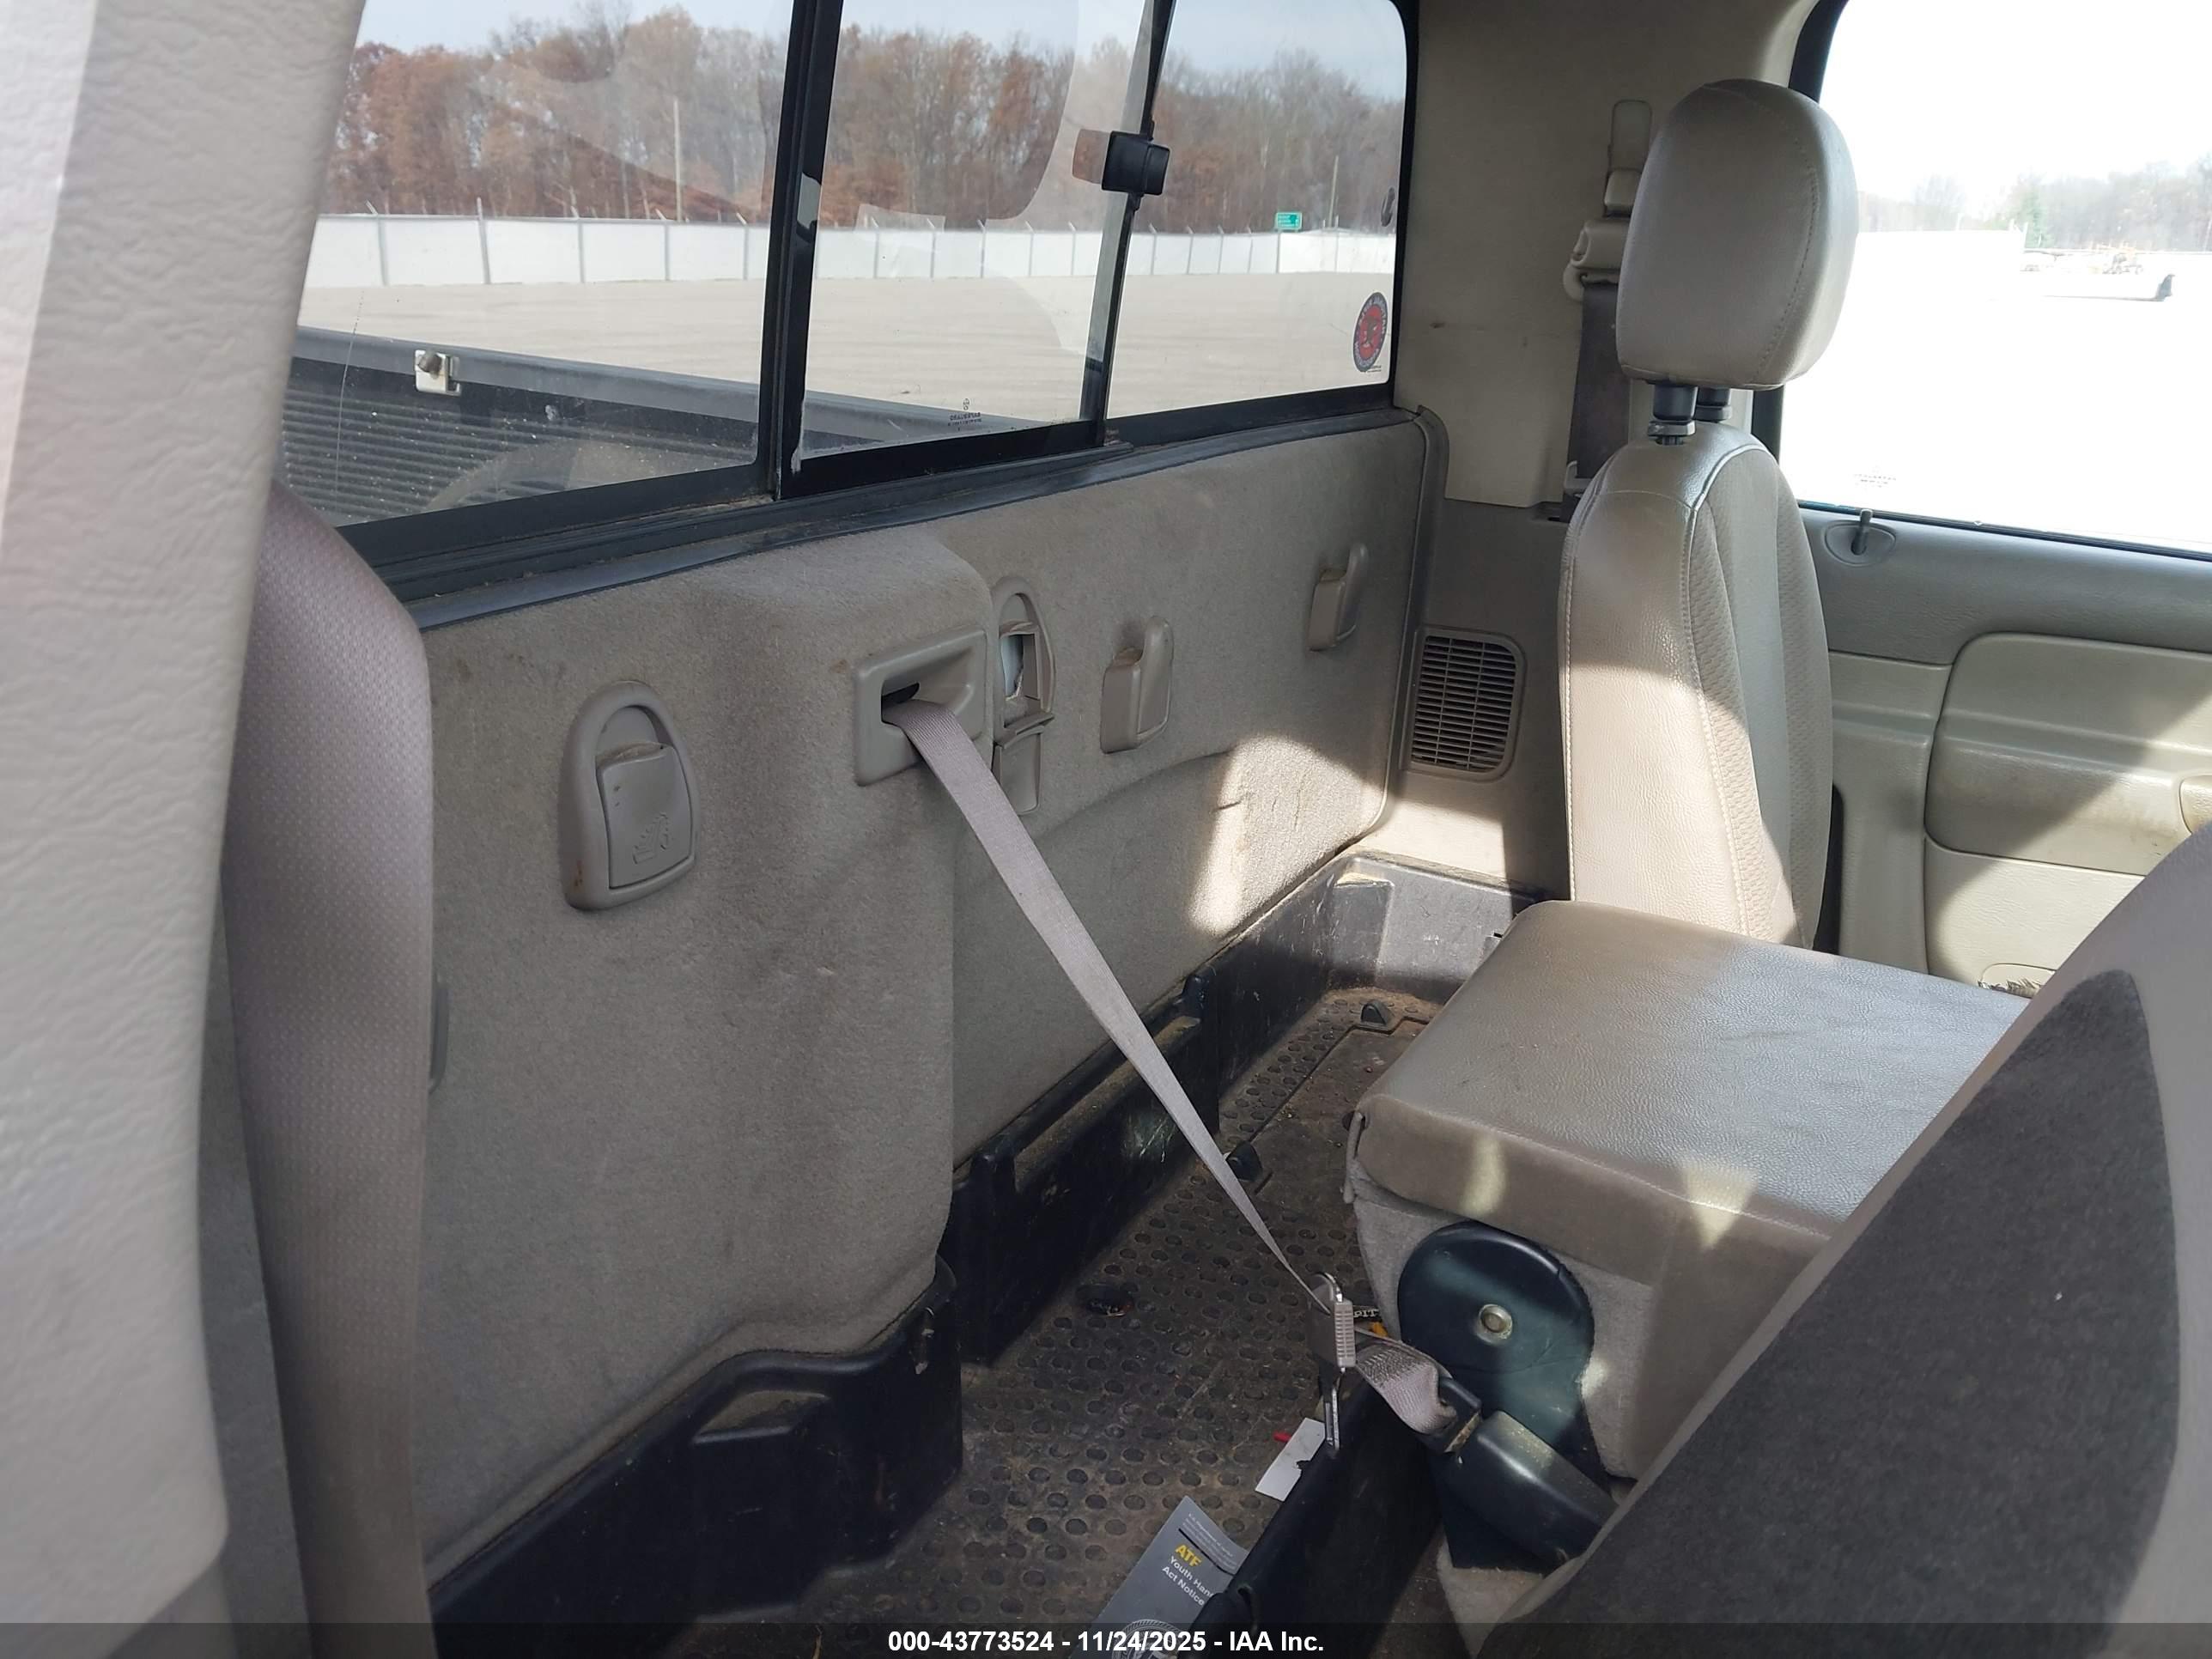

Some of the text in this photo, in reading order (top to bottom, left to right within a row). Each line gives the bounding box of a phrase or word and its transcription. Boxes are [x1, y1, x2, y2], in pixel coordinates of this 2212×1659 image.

[1170, 1555, 1193, 1581] Youth
[1175, 1545, 1202, 1567] ATF
[1162, 1566, 1205, 1606] Act Notice
